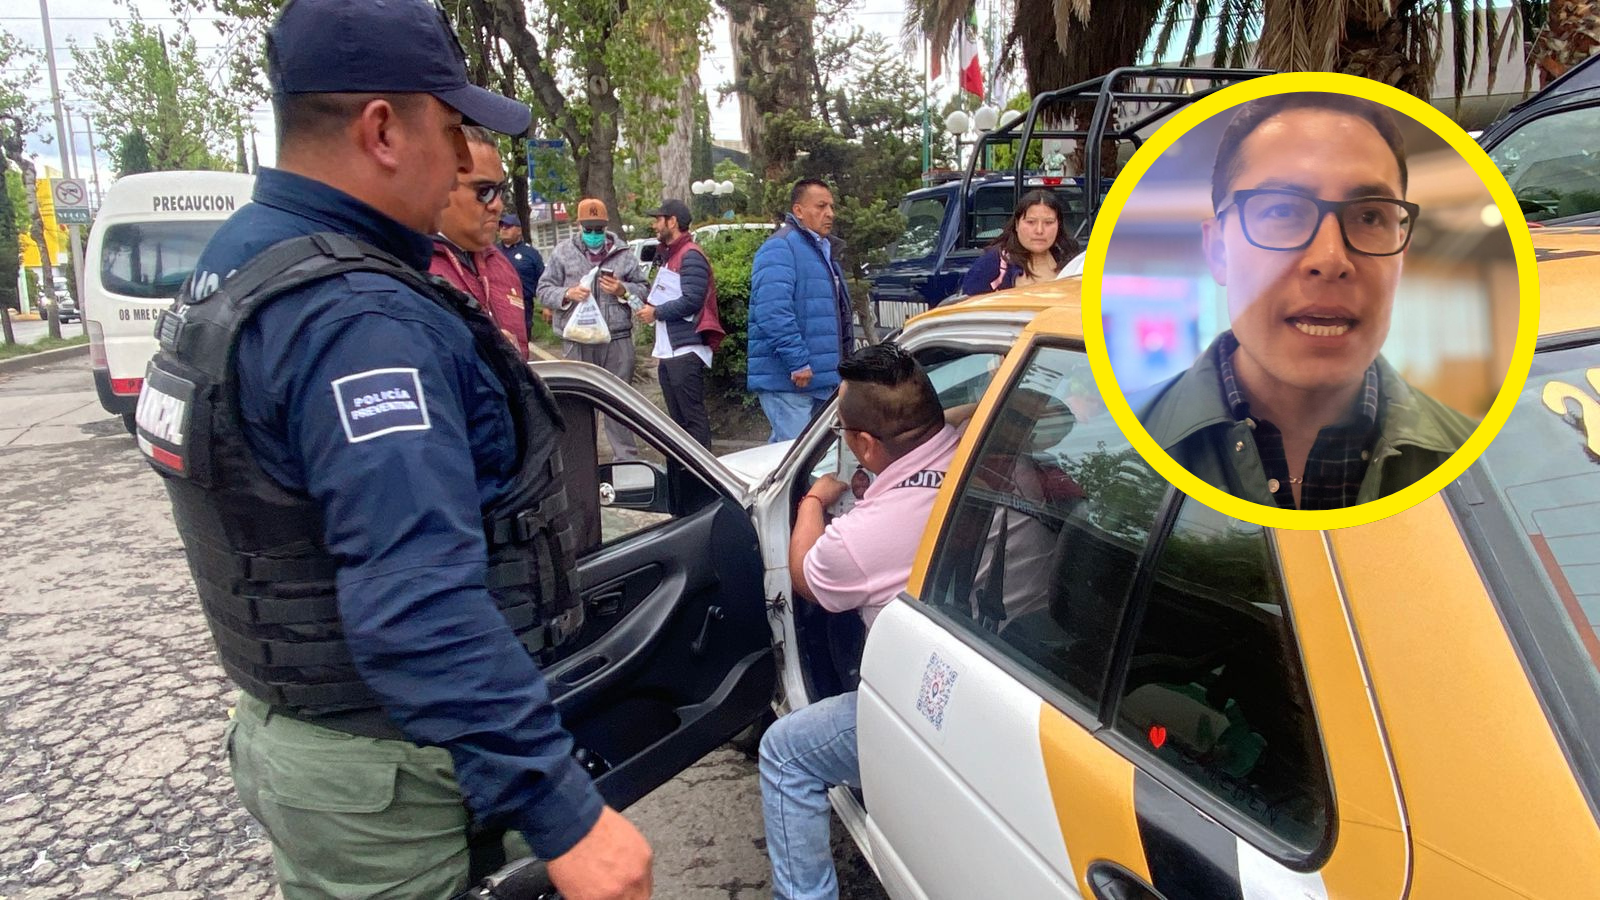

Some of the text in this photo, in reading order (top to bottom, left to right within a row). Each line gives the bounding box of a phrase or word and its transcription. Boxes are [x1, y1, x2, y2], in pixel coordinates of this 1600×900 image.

[153, 195, 235, 211] PRECAUCION
[119, 309, 130, 321] 08
[134, 309, 150, 321] MRE
[353, 387, 411, 407] POLICÍA
[350, 400, 419, 420] PREVENTIVA
[898, 471, 945, 488] KUC
